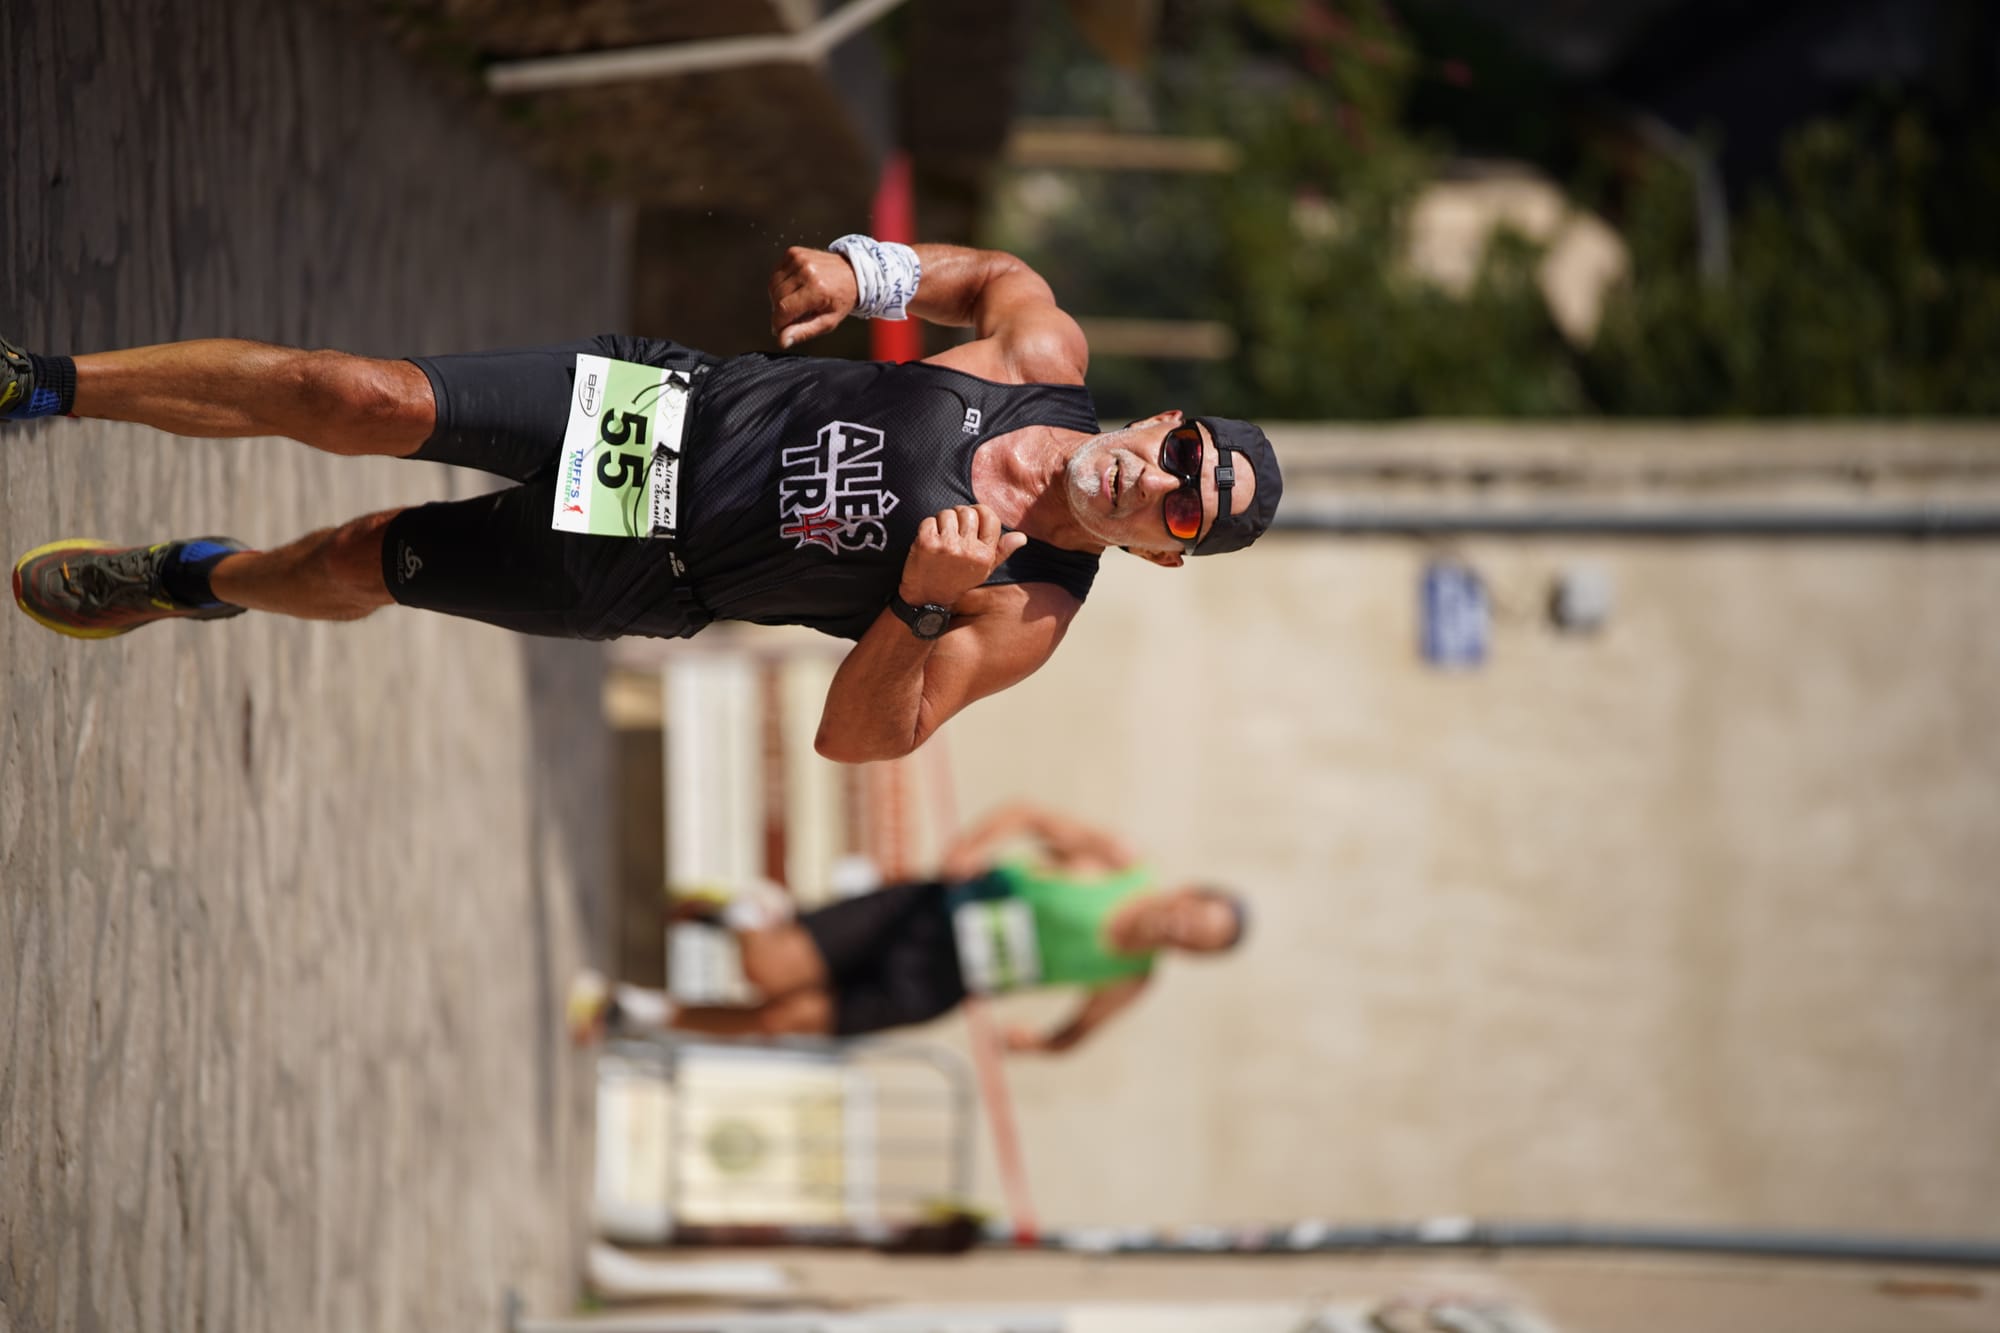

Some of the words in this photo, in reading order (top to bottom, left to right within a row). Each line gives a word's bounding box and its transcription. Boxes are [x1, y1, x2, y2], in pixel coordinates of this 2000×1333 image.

[883, 279, 902, 314] TDM
[585, 374, 597, 411] BFP
[596, 408, 649, 489] 55
[563, 452, 577, 503] Aventure
[570, 448, 584, 499] TUFF'S
[836, 421, 901, 552] ALÈS
[653, 484, 662, 526] cévenole
[663, 506, 672, 526] des
